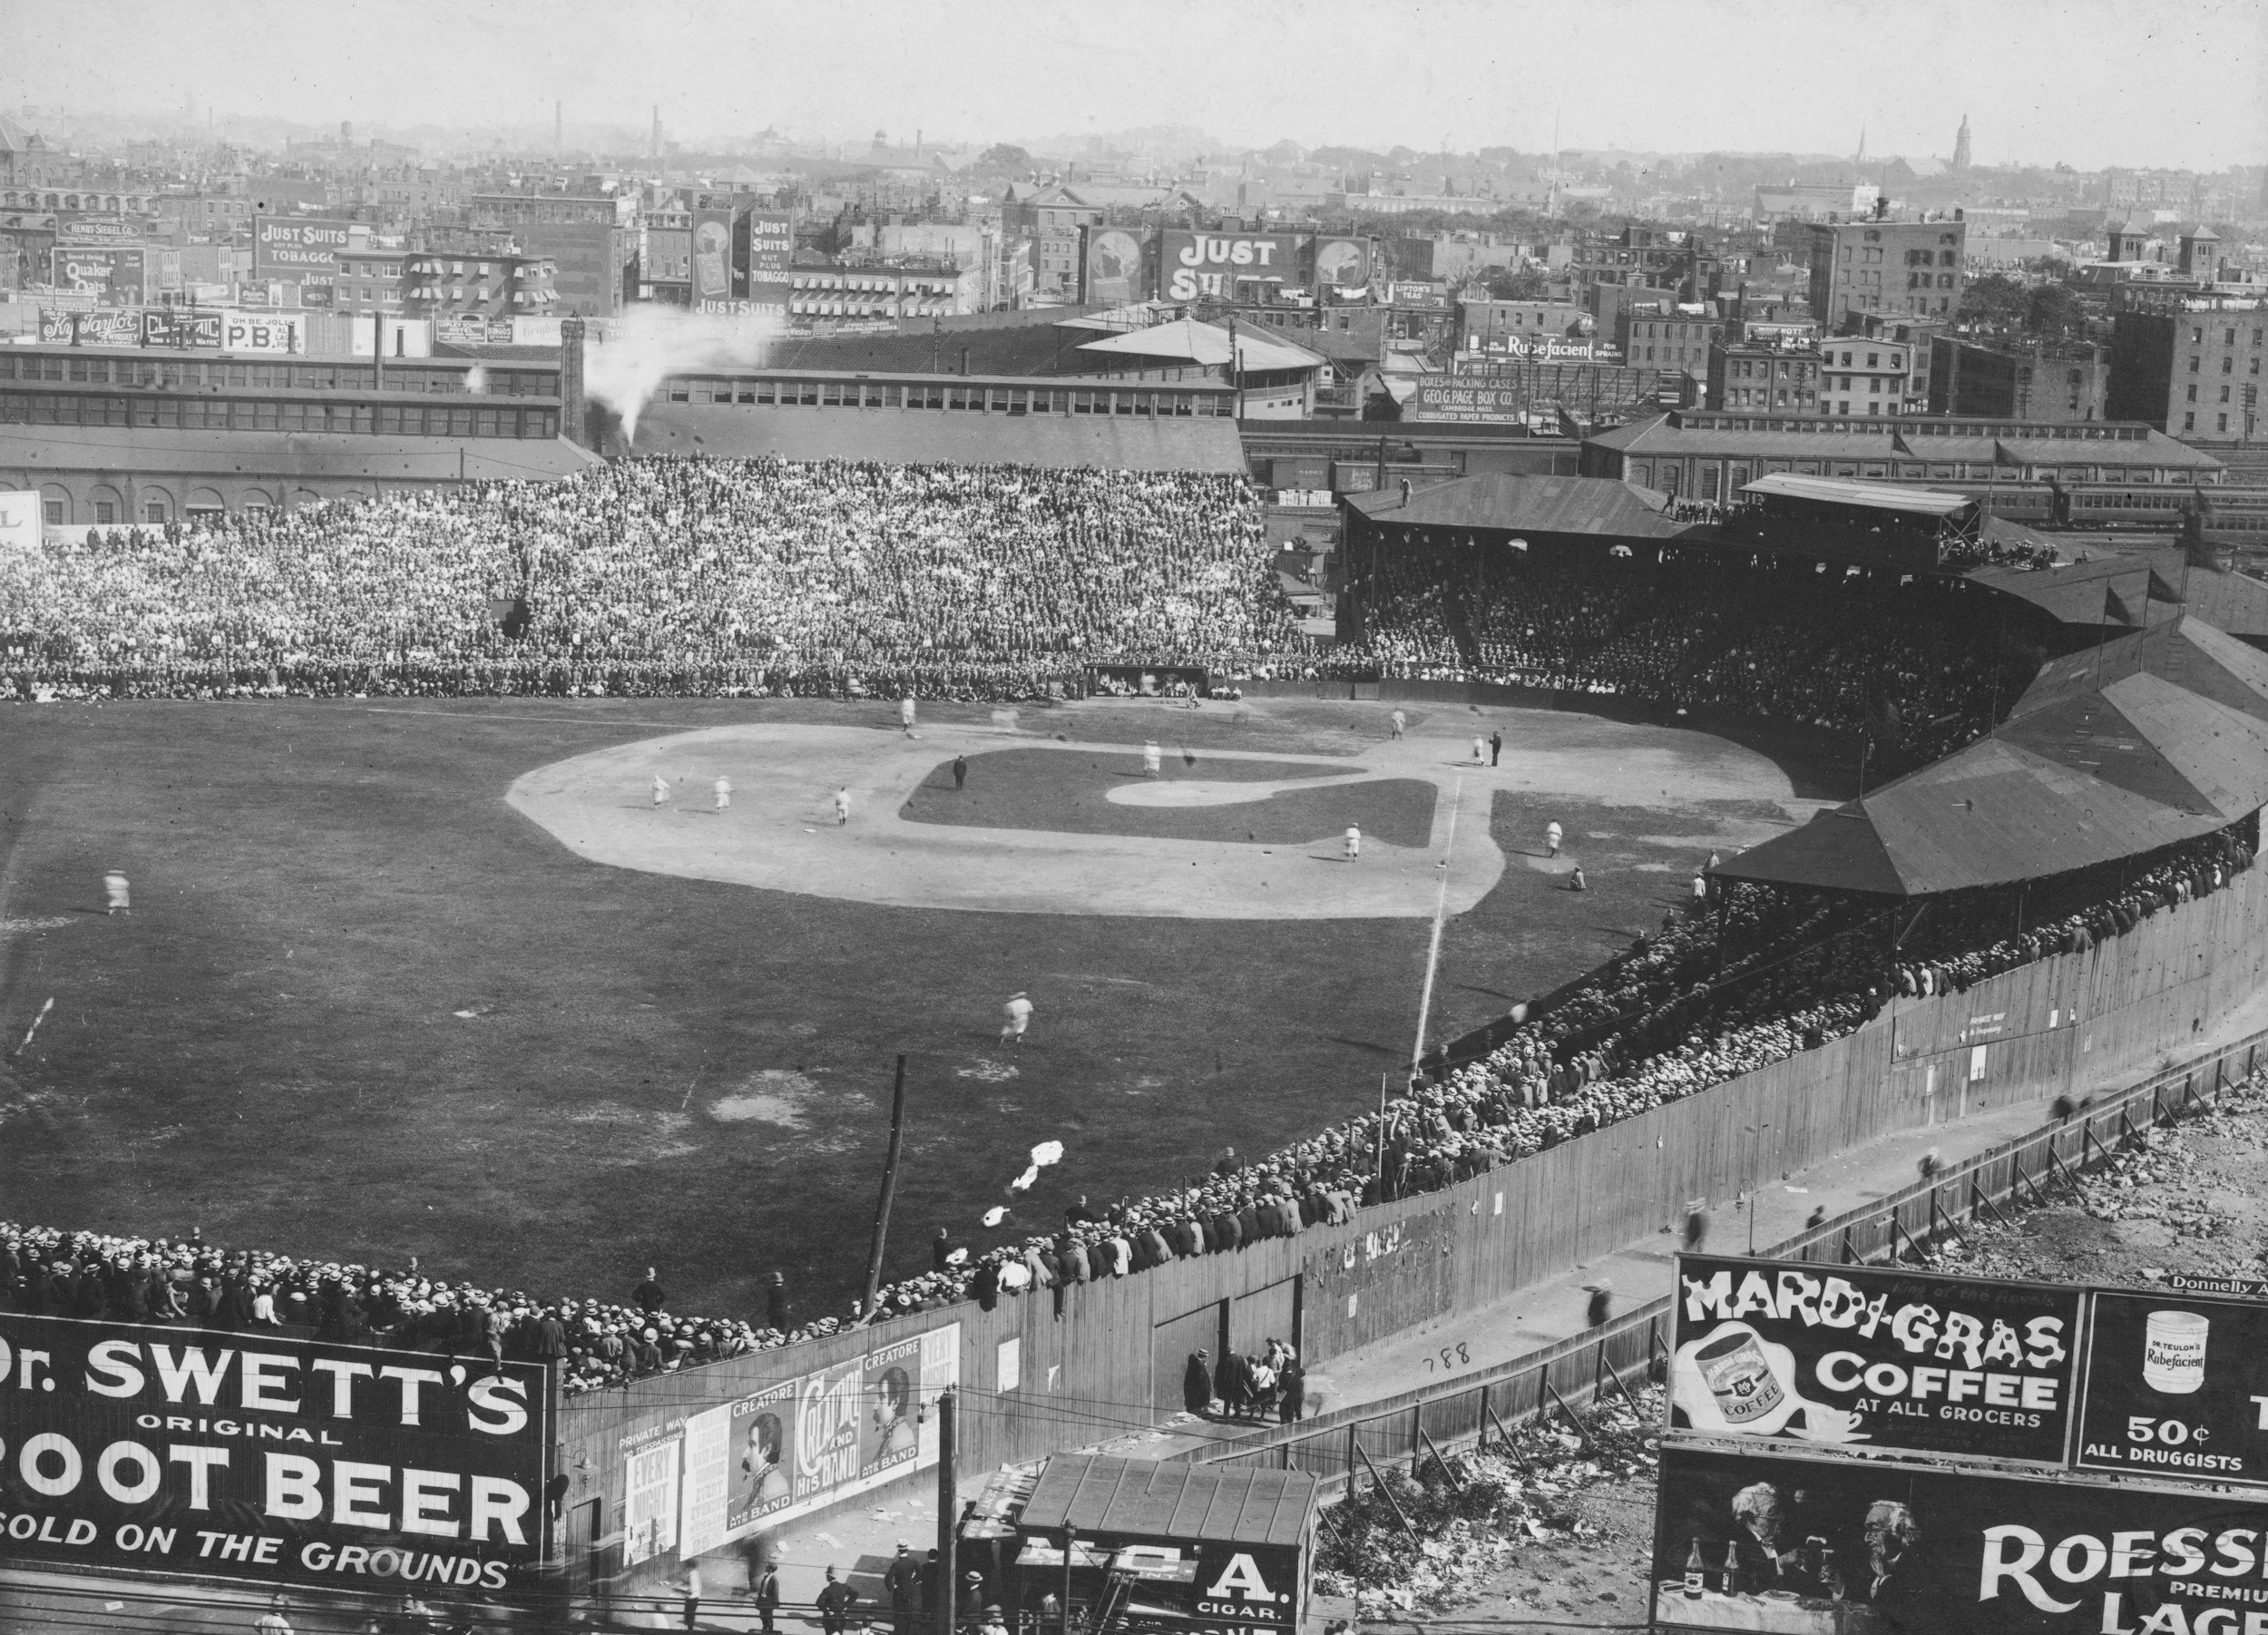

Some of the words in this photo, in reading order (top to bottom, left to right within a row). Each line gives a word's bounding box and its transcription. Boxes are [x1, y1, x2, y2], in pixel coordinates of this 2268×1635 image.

[260, 224, 300, 242] JUST
[303, 226, 347, 245] SUITS
[754, 220, 788, 235] JUST
[753, 238, 789, 252] SUITS
[1179, 235, 1277, 266] JUST
[66, 262, 112, 280] Quaker
[300, 272, 334, 286] JUST
[74, 279, 106, 293] Oats
[1396, 284, 1431, 293] LIPTON'S
[696, 299, 737, 315] JUST
[738, 300, 786, 317] SUITS
[108, 332, 138, 342] WHISKEY
[1420, 376, 1443, 387] BOXES
[1452, 377, 1486, 388] PACKING
[1489, 378, 1518, 389] CASES
[1452, 390, 1474, 405] PAGE
[1478, 391, 1497, 406] BOX
[1500, 391, 1513, 406] CO.
[1418, 411, 1458, 420] CORRUGATED
[1460, 413, 1480, 421] PAPER
[1481, 413, 1514, 422] PRODUCTS
[2173, 1276, 2252, 1294] Donnelly
[1681, 1270, 2066, 1370] MARDI-GRAS
[865, 1340, 920, 1371] CREATORE
[2147, 1347, 2204, 1371] Rubefacient
[2163, 1343, 2201, 1353] TEULON'S
[0, 1335, 55, 1392] r.
[85, 1338, 529, 1435] SWETT'S
[1816, 1350, 2058, 1417] COFFEE
[733, 1385, 794, 1418] CREATORE
[1724, 1383, 1779, 1416] COFFEE
[1854, 1397, 1882, 1413] AT
[1888, 1401, 1930, 1418] ALL
[1939, 1405, 2041, 1429] GROCERS
[135, 1414, 343, 1446] ORIGINAL
[619, 1425, 660, 1450] PRIVATE
[667, 1415, 688, 1432] WAY
[829, 1431, 854, 1450] AND
[2126, 1415, 2211, 1446] 50¢
[634, 1446, 671, 1490] EVERY
[797, 1474, 820, 1497] HIS
[822, 1444, 857, 1488] BAND
[863, 1462, 879, 1472] AND
[881, 1446, 916, 1469] BAND
[2085, 1444, 2122, 1459] ALL
[2129, 1447, 2243, 1471] DRUGGISTS
[0, 1433, 229, 1510] OOT
[264, 1452, 532, 1545] BEER
[730, 1511, 748, 1522] AND
[751, 1496, 790, 1518] BAND
[115, 1523, 177, 1554] ON
[197, 1530, 284, 1564] THE
[300, 1542, 510, 1590] GROUNDS
[1978, 1523, 2268, 1614] ROESS
[1206, 1552, 1290, 1603] A.
[1197, 1601, 1282, 1620] CIGAR.
